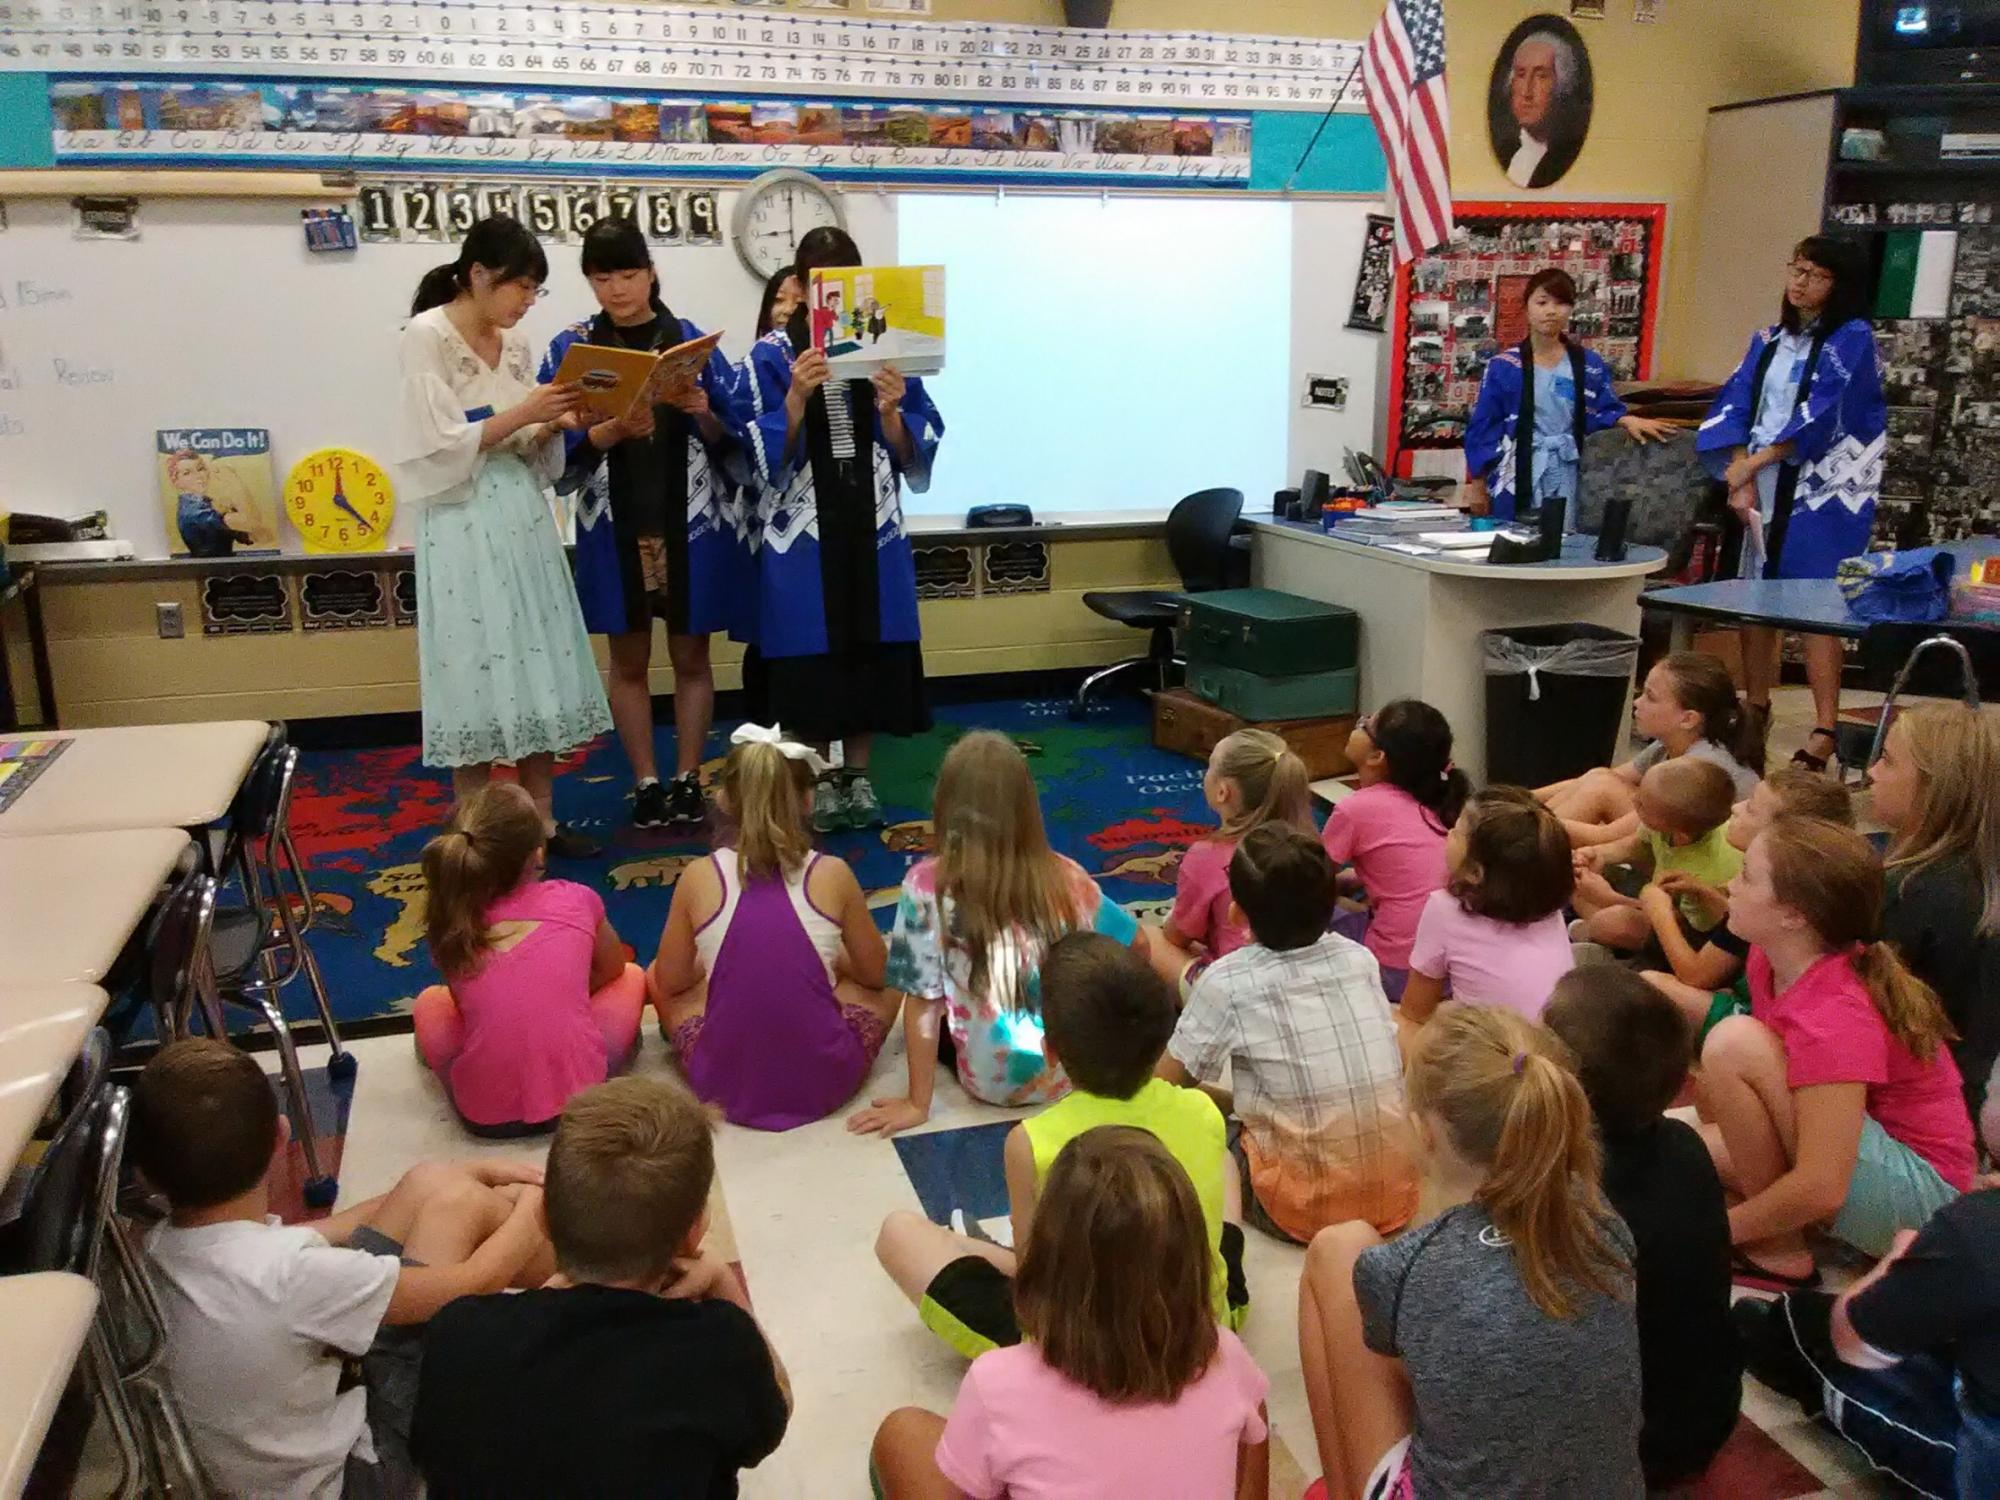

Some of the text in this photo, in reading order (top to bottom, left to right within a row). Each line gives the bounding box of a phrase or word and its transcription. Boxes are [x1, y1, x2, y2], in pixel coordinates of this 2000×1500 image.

[439, 16, 451, 30] 0
[470, 17, 476, 31] 1
[496, 18, 507, 31] 2
[526, 19, 535, 32] 3
[553, 19, 564, 33] 4
[580, 20, 590, 35] 5
[608, 22, 618, 36] 6
[634, 23, 644, 36] 7
[662, 24, 672, 37] 8
[688, 24, 698, 38] 9
[712, 26, 726, 39] 10
[736, 28, 747, 40] 11
[760, 29, 774, 43] 12
[786, 32, 801, 44] 13
[812, 33, 826, 45] 14
[837, 34, 851, 47] 15
[862, 36, 876, 49] 16
[887, 37, 900, 50] 17
[911, 41, 924, 52] 18
[935, 39, 950, 52] 19
[959, 40, 976, 54] 20
[981, 41, 994, 53] 21
[1026, 43, 1044, 56] 23
[1050, 44, 1067, 57] 24
[1074, 46, 1091, 58] 25
[1096, 46, 1111, 59] 26
[1116, 46, 1132, 60] 27
[1139, 47, 1154, 59] 28
[1161, 47, 1177, 59] 29
[1185, 47, 1201, 60] 30
[1203, 48, 1216, 62] 31
[1224, 49, 1239, 63] 32
[1246, 51, 1260, 64] 33
[1267, 52, 1283, 65] 34
[1288, 53, 1303, 66] 35
[1330, 56, 1345, 67] 37
[210, 44, 231, 59] 53
[240, 46, 261, 59] 54
[269, 45, 290, 60] 55
[299, 47, 319, 60] 56
[329, 48, 348, 61] 57
[359, 49, 378, 62] 58
[388, 50, 406, 63] 59
[416, 51, 435, 64] 60
[440, 52, 455, 65] 61
[468, 54, 487, 66] 62
[496, 54, 515, 67] 63
[524, 55, 543, 68] 64
[552, 57, 570, 70] 65
[579, 57, 597, 71] 66
[606, 59, 624, 73] 67
[634, 60, 651, 73] 68
[660, 62, 678, 74] 69
[688, 62, 705, 75] 70
[710, 64, 723, 76] 71
[734, 65, 751, 78] 72
[760, 65, 777, 79] 73
[785, 66, 802, 79] 74
[810, 68, 827, 81] 75
[834, 68, 851, 82] 76
[859, 70, 876, 83] 77
[884, 72, 901, 84] 78
[909, 73, 926, 85] 79
[934, 73, 950, 86] 80
[953, 74, 967, 87] 81
[976, 75, 993, 88] 82
[1000, 76, 1017, 88] 83
[1046, 76, 1062, 90] 85
[1069, 78, 1085, 91] 86
[1092, 80, 1108, 92] 87
[1138, 82, 1153, 93] 89
[1161, 81, 1176, 94] 90
[1179, 83, 1191, 96] 91
[1201, 84, 1217, 95] 92
[1223, 84, 1239, 96] 93
[1245, 84, 1260, 96] 94
[1308, 88, 1323, 99] 97
[372, 192, 388, 229] 1
[413, 194, 431, 229] 2
[453, 194, 473, 230] 3
[534, 194, 554, 230] 5
[575, 198, 594, 231] 6
[656, 198, 672, 232] 8
[694, 198, 714, 232] 9
[816, 203, 823, 216] 2
[751, 229, 759, 239] 9
[760, 246, 767, 258] 8
[164, 431, 264, 449] We Can Do It!
[327, 457, 343, 470] 12
[351, 461, 359, 473] 1
[309, 464, 324, 477] 11
[296, 479, 314, 493] 10
[366, 473, 376, 486] 2
[295, 496, 305, 509] 9
[374, 492, 384, 505] 3
[305, 514, 314, 526] 8
[370, 511, 379, 523] 4
[321, 526, 330, 538] 7
[339, 528, 348, 541] 6
[357, 523, 367, 536] 5
